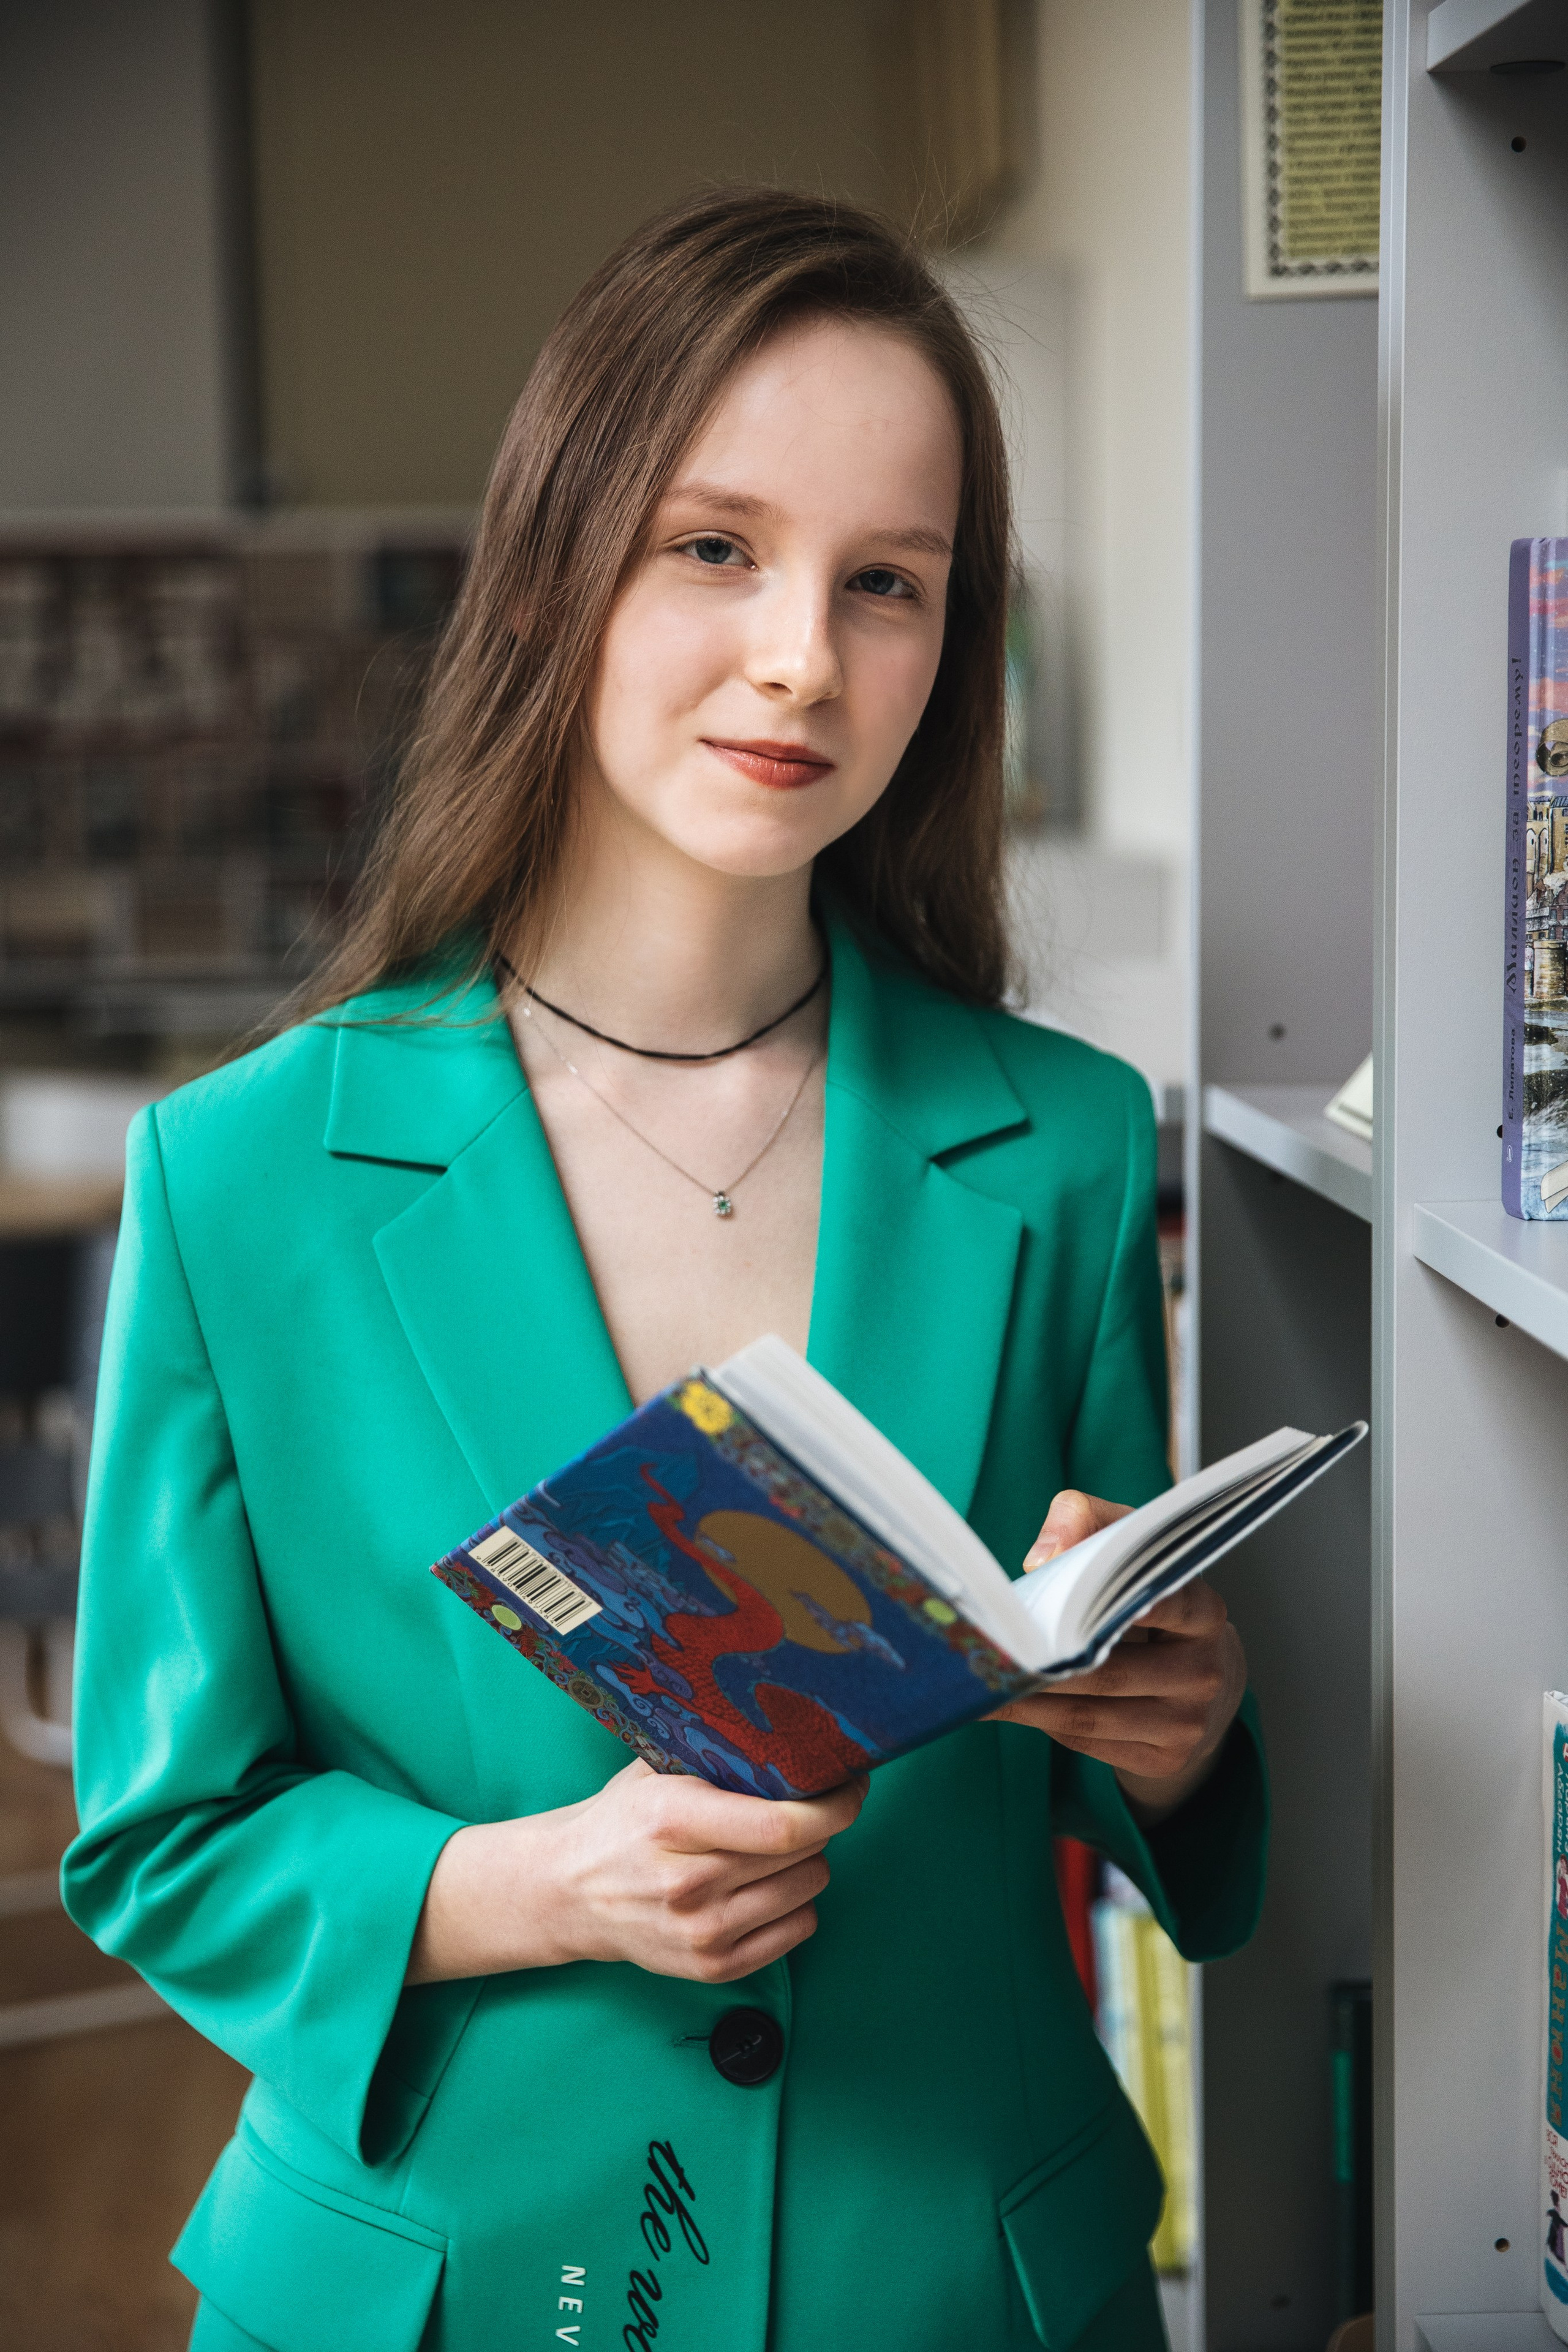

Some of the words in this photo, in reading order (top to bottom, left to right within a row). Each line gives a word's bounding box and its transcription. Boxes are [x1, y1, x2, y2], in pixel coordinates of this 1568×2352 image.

[1512, 657, 1524, 796] теорему!
[1512, 812, 1520, 842] за
[1506, 858, 1520, 994] Миллион
[1508, 1108, 1514, 1120] Е.
[1551, 1922, 1568, 2127] Манюня
[640, 2141, 709, 2265] the
[556, 2265, 586, 2346] NEV
